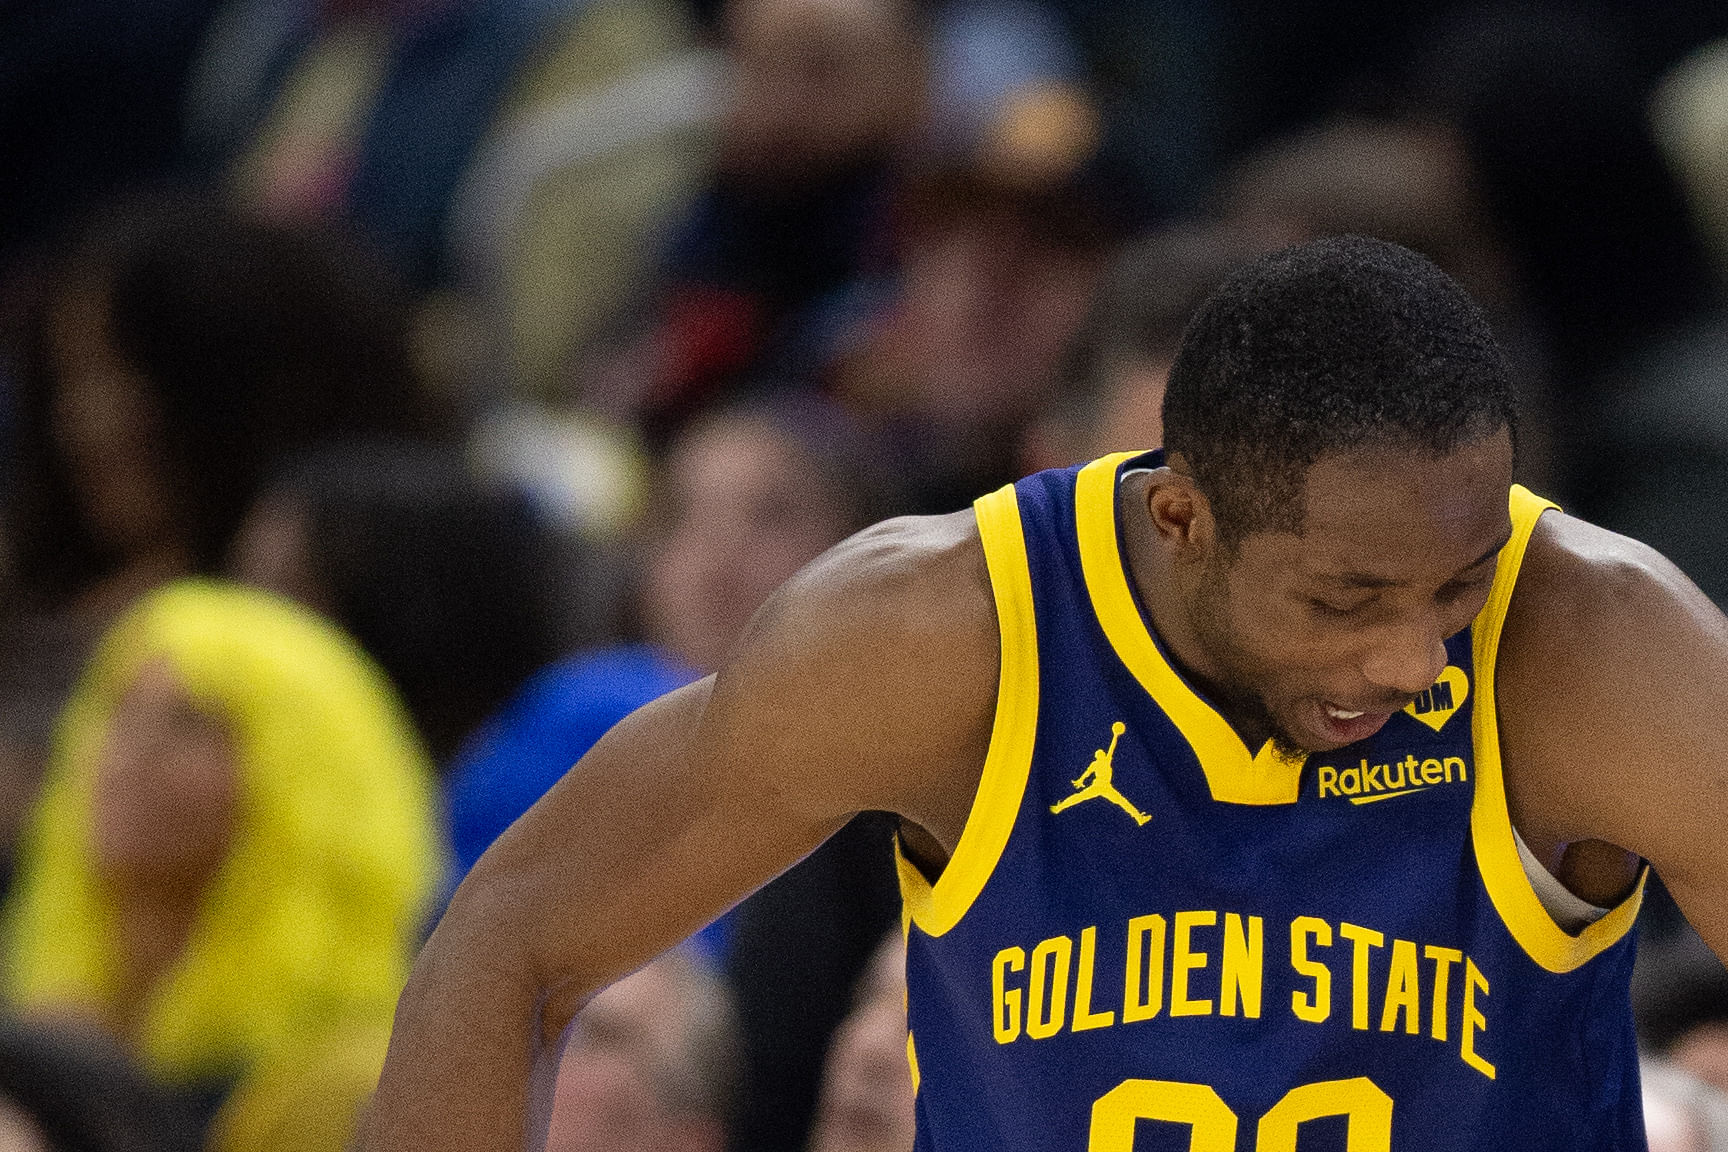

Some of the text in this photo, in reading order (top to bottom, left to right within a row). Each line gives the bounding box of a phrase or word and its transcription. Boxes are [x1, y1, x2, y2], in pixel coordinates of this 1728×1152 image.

[1318, 754, 1467, 798] Rakuten
[993, 912, 1497, 1081] GOLDEN STATE
